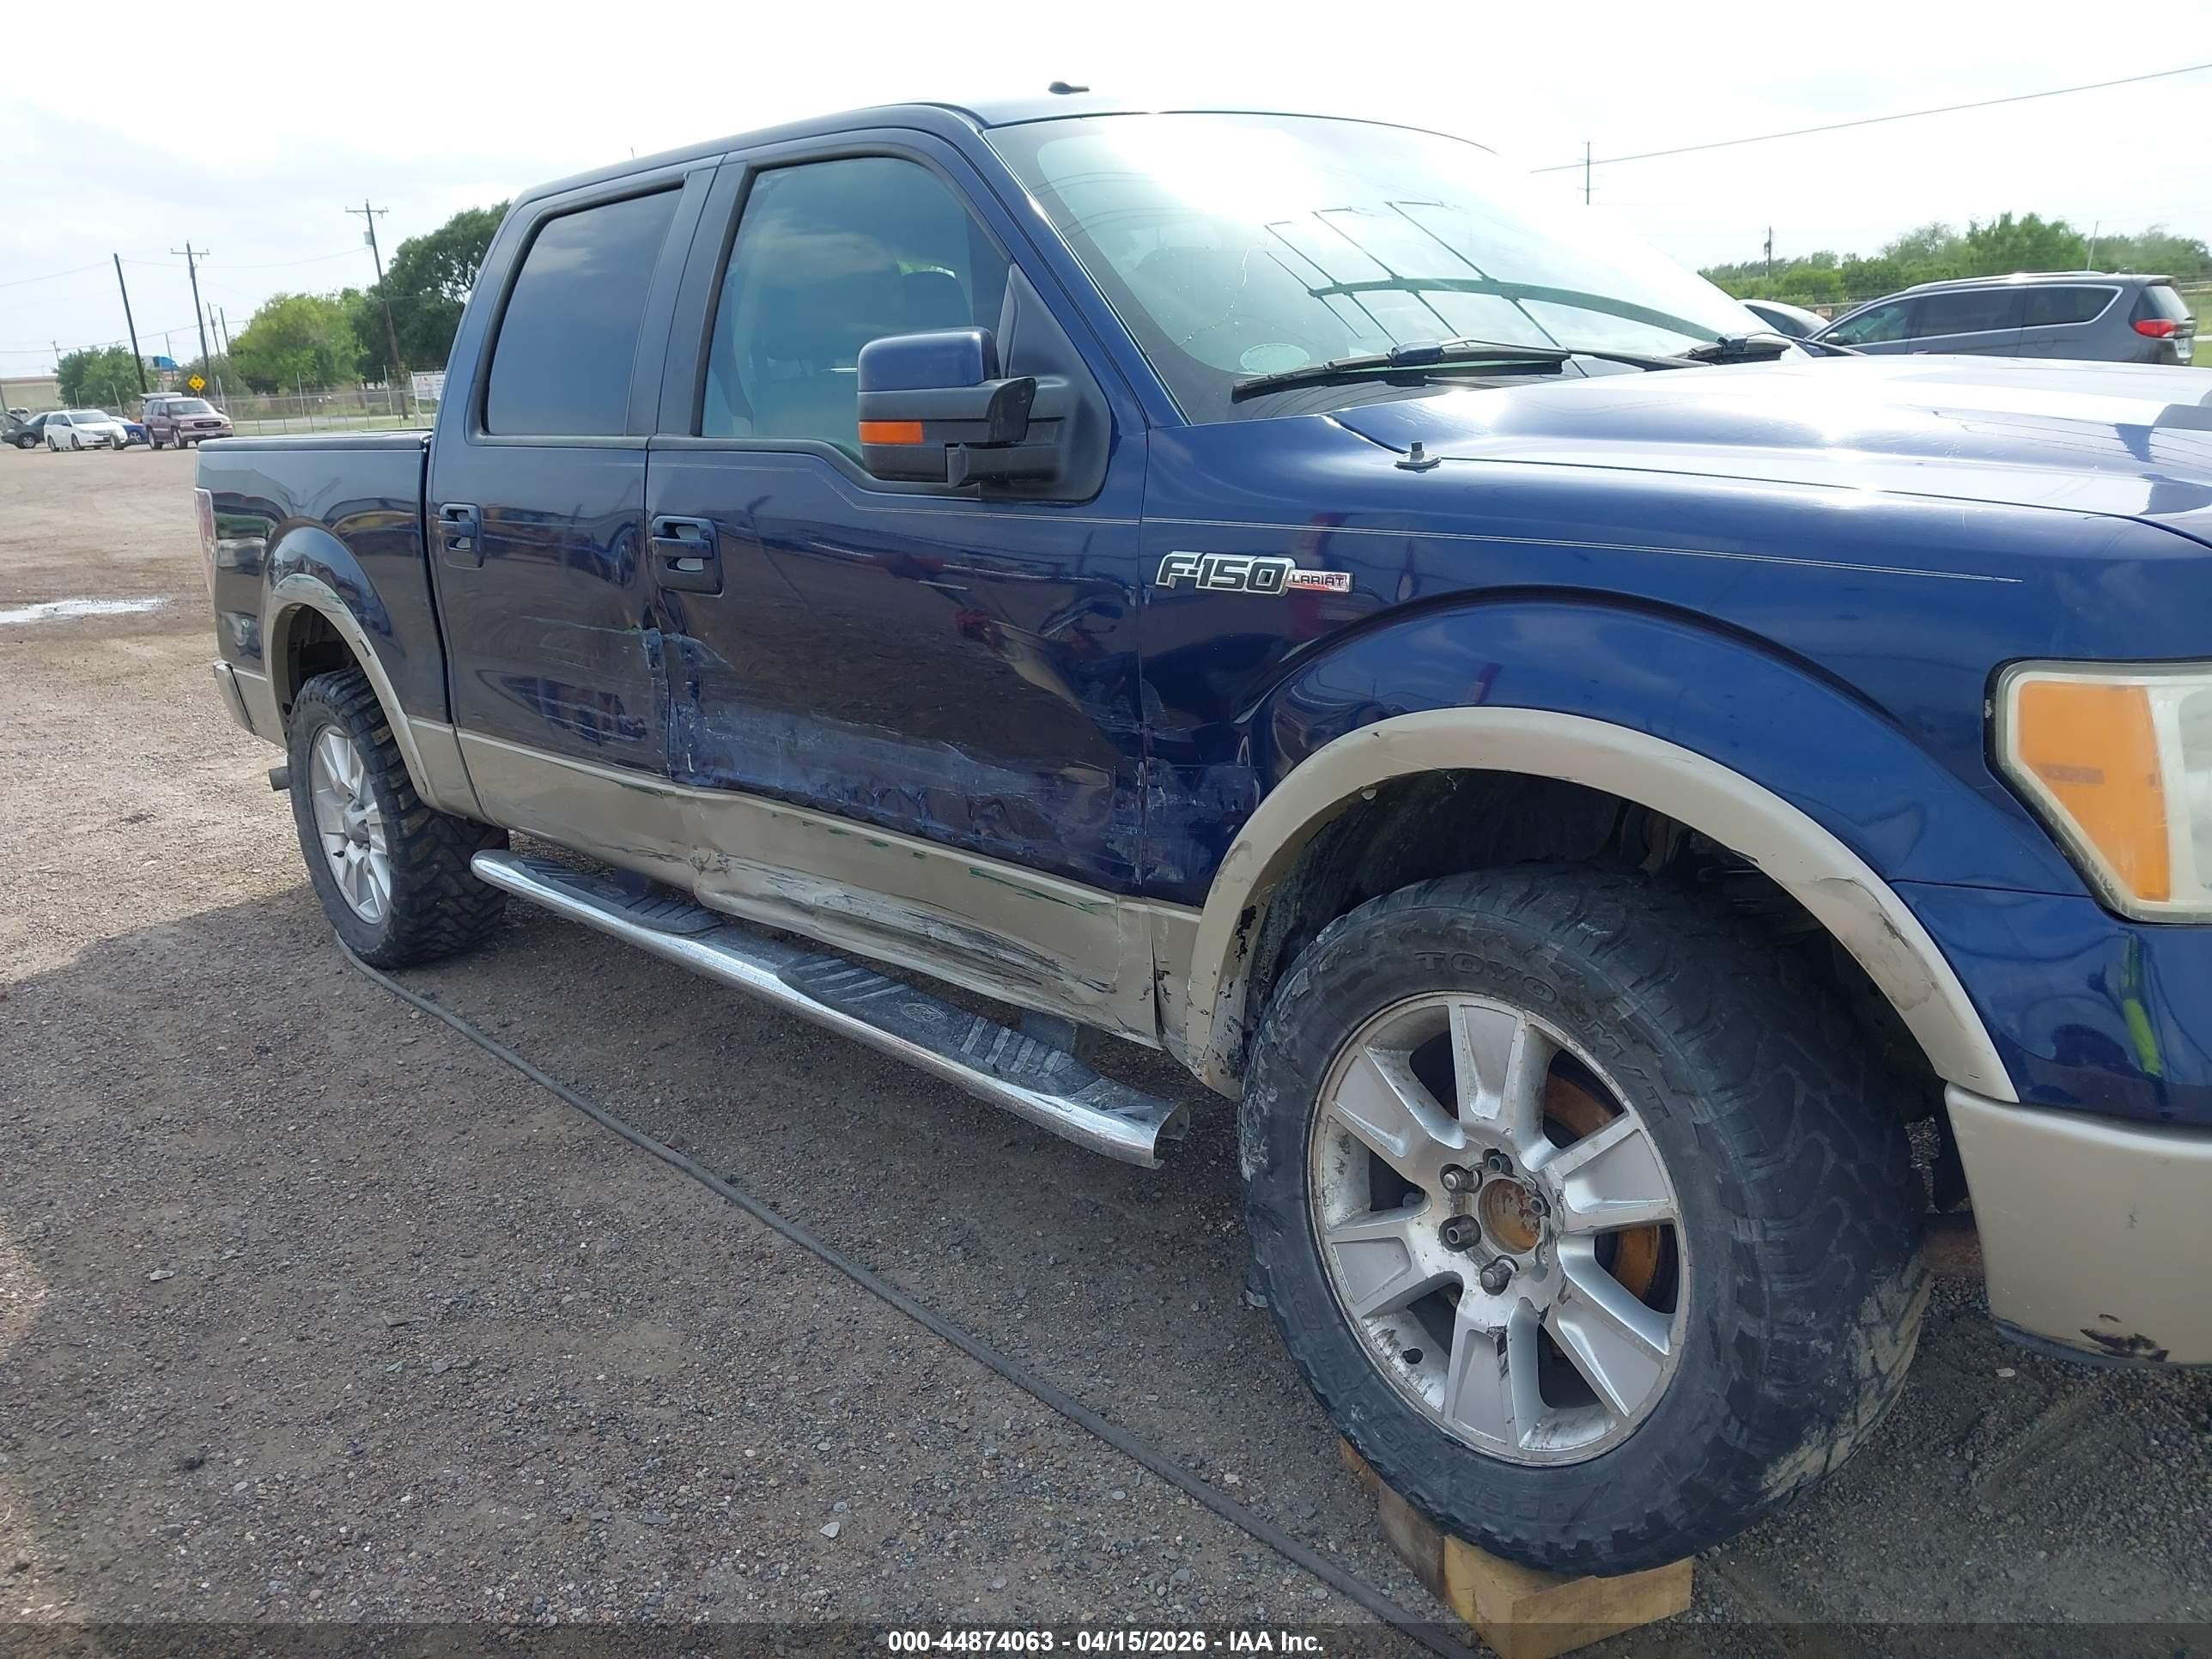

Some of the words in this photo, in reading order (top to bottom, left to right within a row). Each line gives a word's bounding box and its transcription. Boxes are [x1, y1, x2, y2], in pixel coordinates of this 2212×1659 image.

[1156, 551, 1297, 596] F-150
[1291, 572, 1346, 588] LARIAT
[1414, 951, 1559, 1004] TOYO
